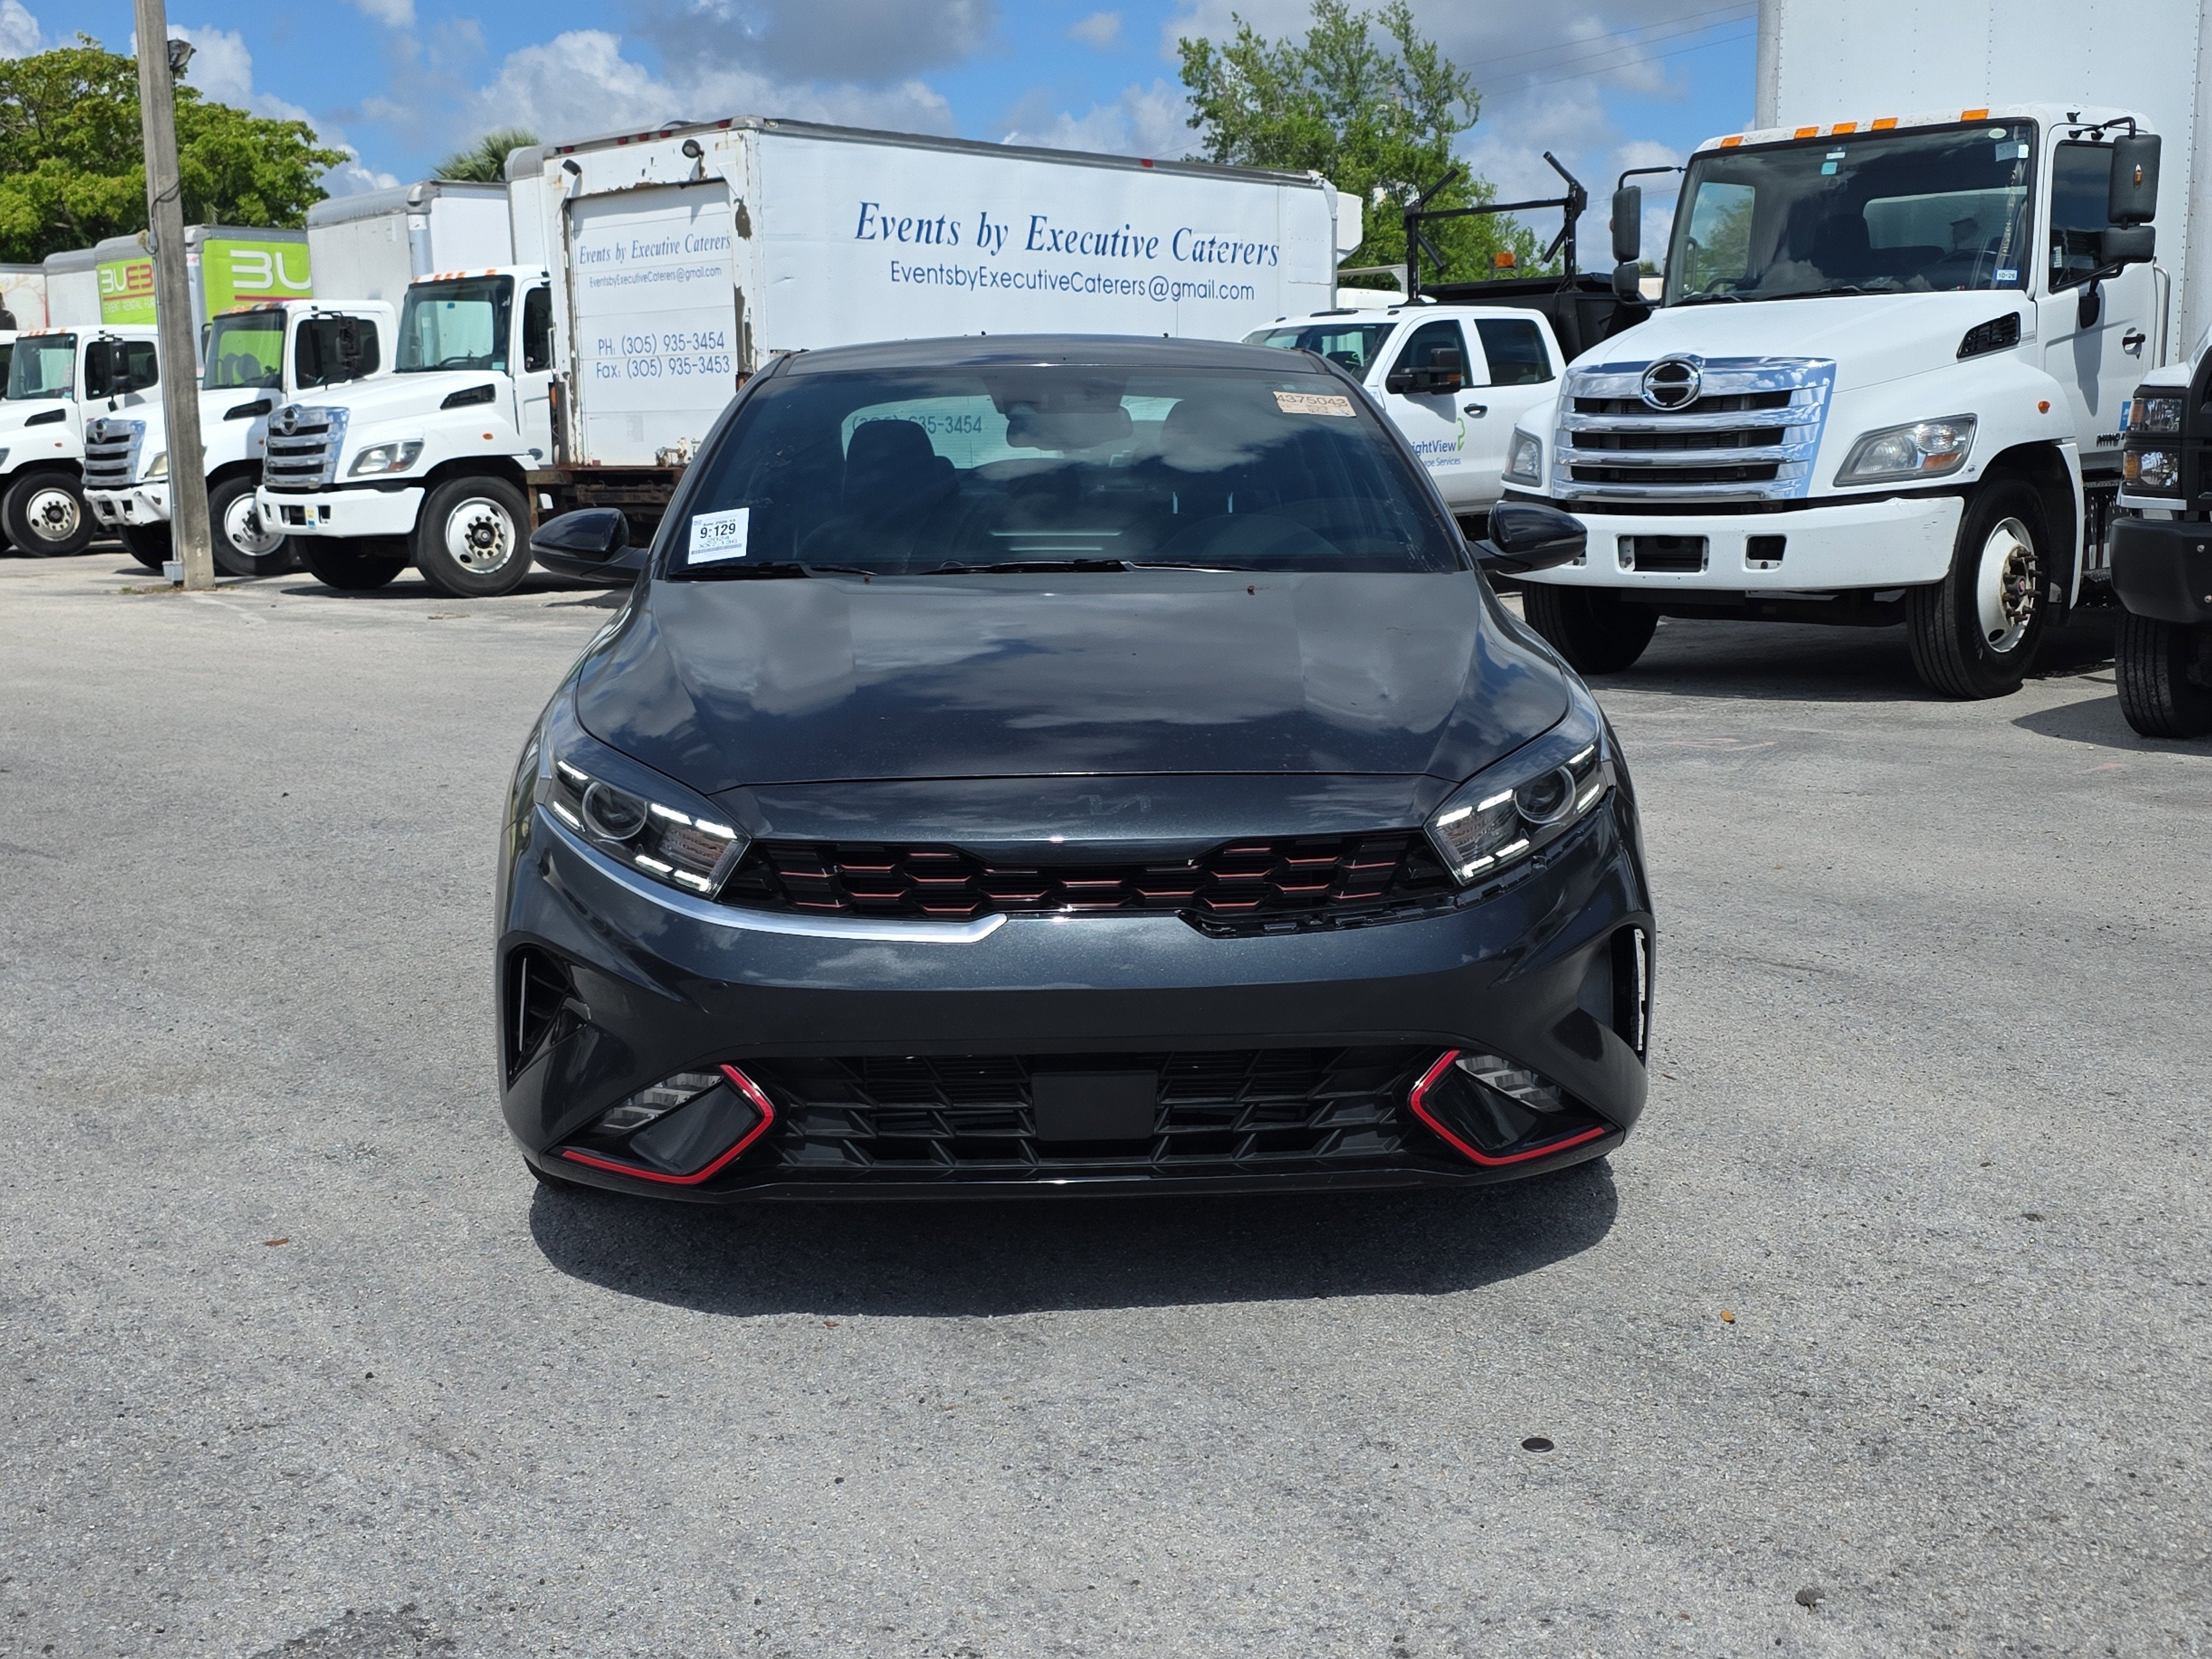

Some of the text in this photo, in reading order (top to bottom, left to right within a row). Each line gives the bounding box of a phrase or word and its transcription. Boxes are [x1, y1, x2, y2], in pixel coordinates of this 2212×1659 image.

[854, 201, 1280, 267] Events by Executive Caterers
[580, 233, 731, 265] Events by Executive Caterers
[589, 266, 722, 288] EventsbyExecutiveCaterers@gmail.com
[890, 260, 1255, 302] EventsbyExecutiveCaterers@gmail.com
[622, 333, 657, 356] (305)
[664, 331, 725, 352] 935-3454
[596, 355, 730, 379] Fax: (305) 935-3453
[1412, 439, 1457, 458] ightView
[1436, 456, 1461, 466] Services
